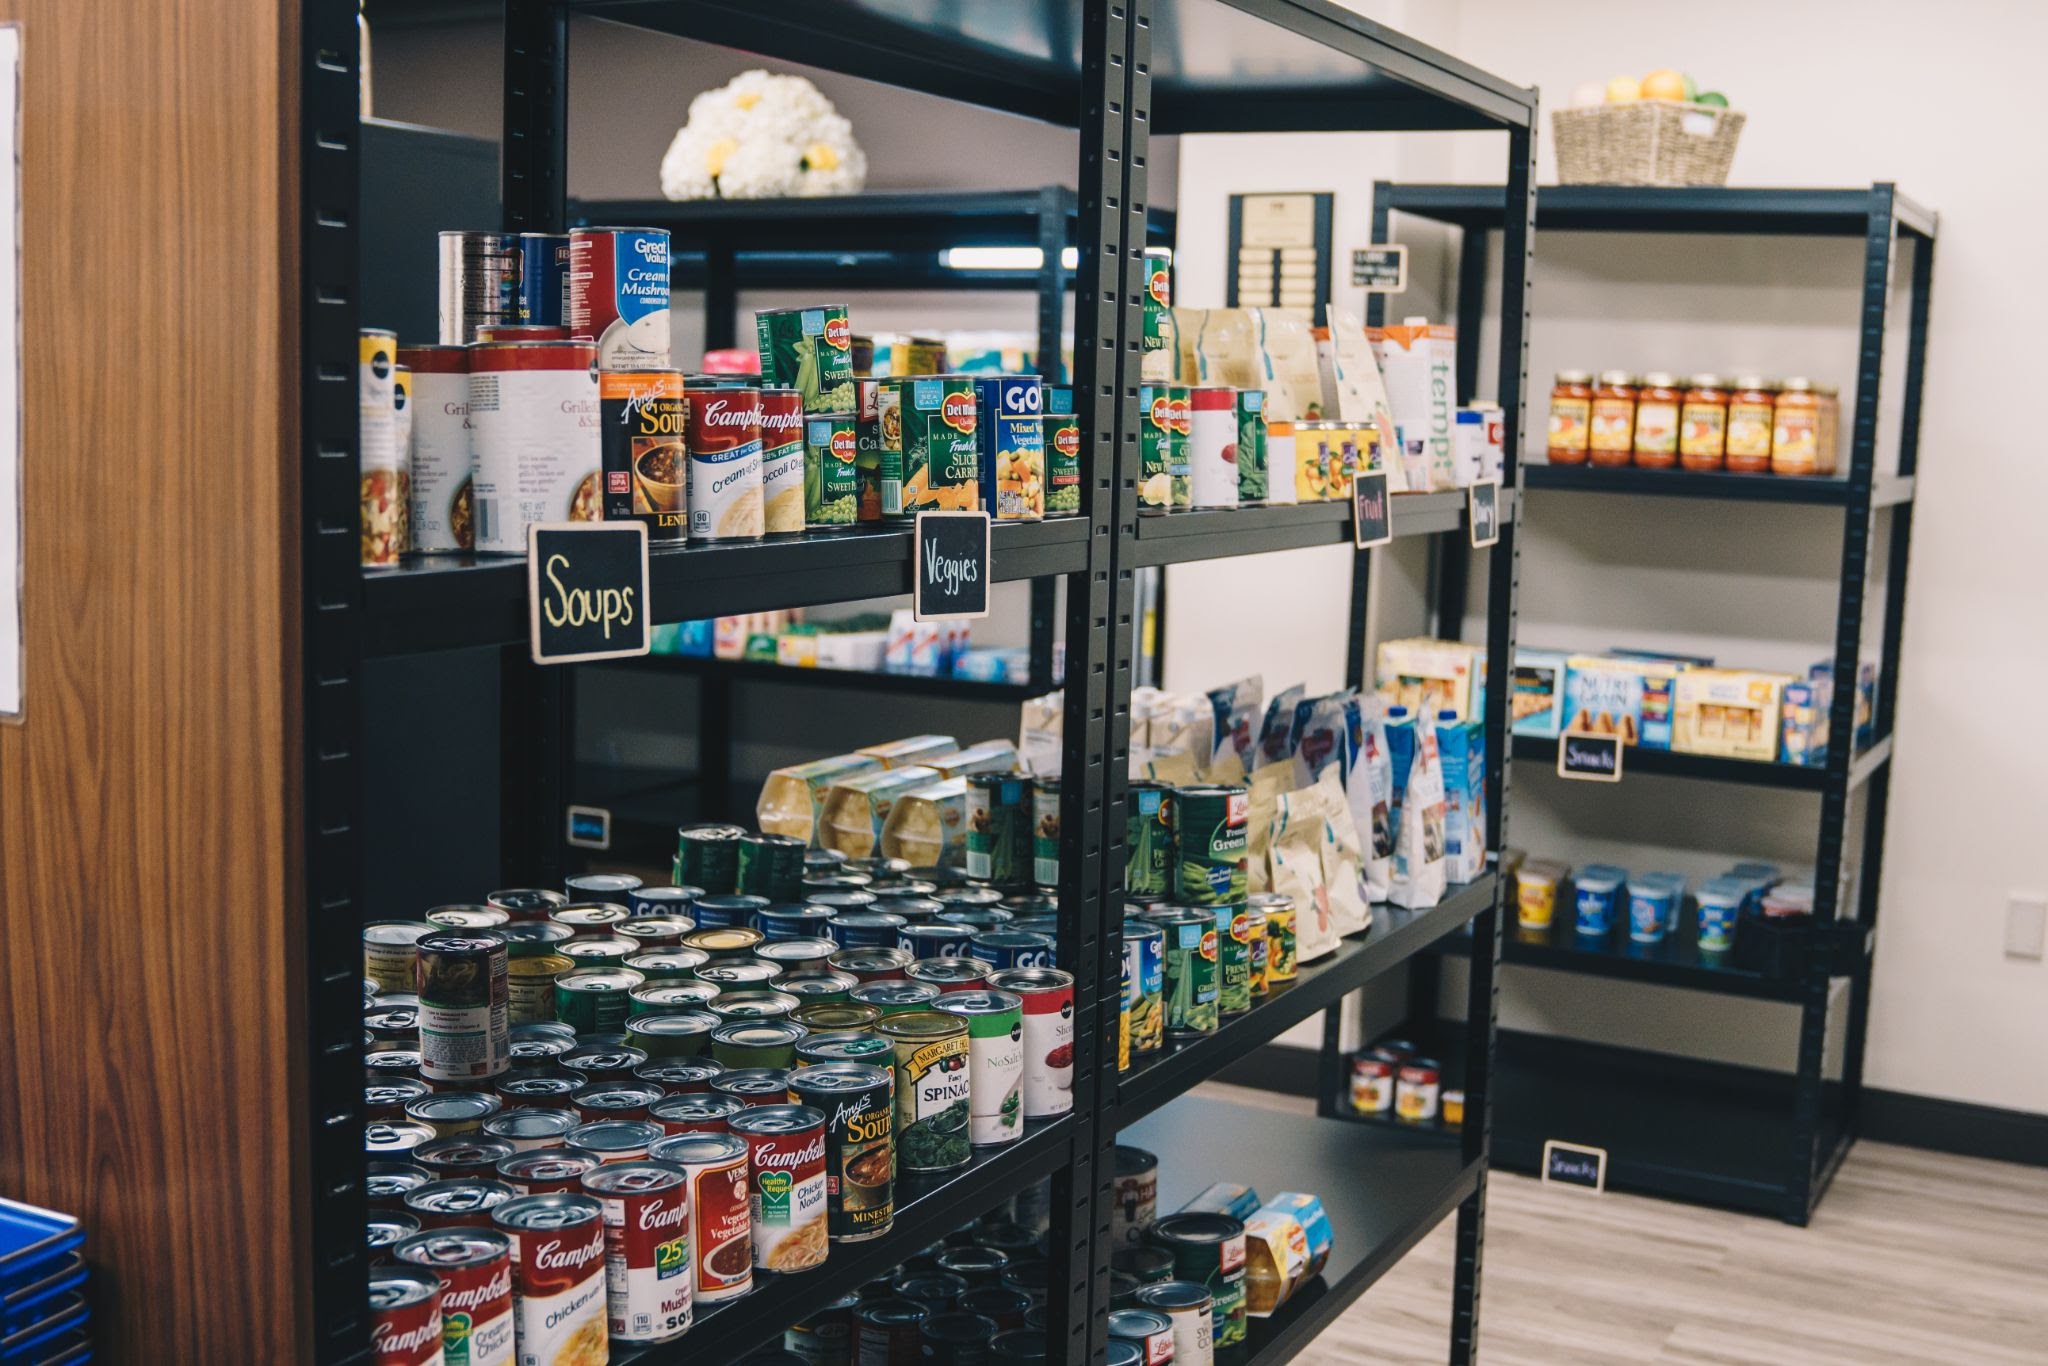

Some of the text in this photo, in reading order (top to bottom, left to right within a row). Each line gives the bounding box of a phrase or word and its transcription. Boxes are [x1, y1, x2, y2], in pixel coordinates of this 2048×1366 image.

[635, 238, 666, 254] Great
[645, 253, 666, 263] Value
[628, 268, 665, 281] Cream
[828, 328, 839, 337] Del
[620, 379, 666, 425] Amy's
[947, 404, 961, 416] Del
[1010, 422, 1034, 433] Mixed
[834, 440, 845, 449] Del
[711, 449, 740, 462] GREAT
[778, 447, 790, 456] FAT
[763, 461, 788, 484] occoli
[712, 467, 746, 493] Cream
[828, 481, 850, 492] SWEET
[1358, 490, 1383, 520] Fruit
[697, 510, 707, 522] 90
[925, 537, 978, 596] Veggies
[544, 554, 634, 640] Soups
[1213, 839, 1244, 852] Green
[918, 1041, 958, 1064] MARGARET
[830, 1094, 871, 1133] Amy's
[762, 1178, 787, 1186] Healthy
[767, 1184, 793, 1194] Request
[545, 1294, 589, 1330] Chicken
[636, 1316, 648, 1325] 110
